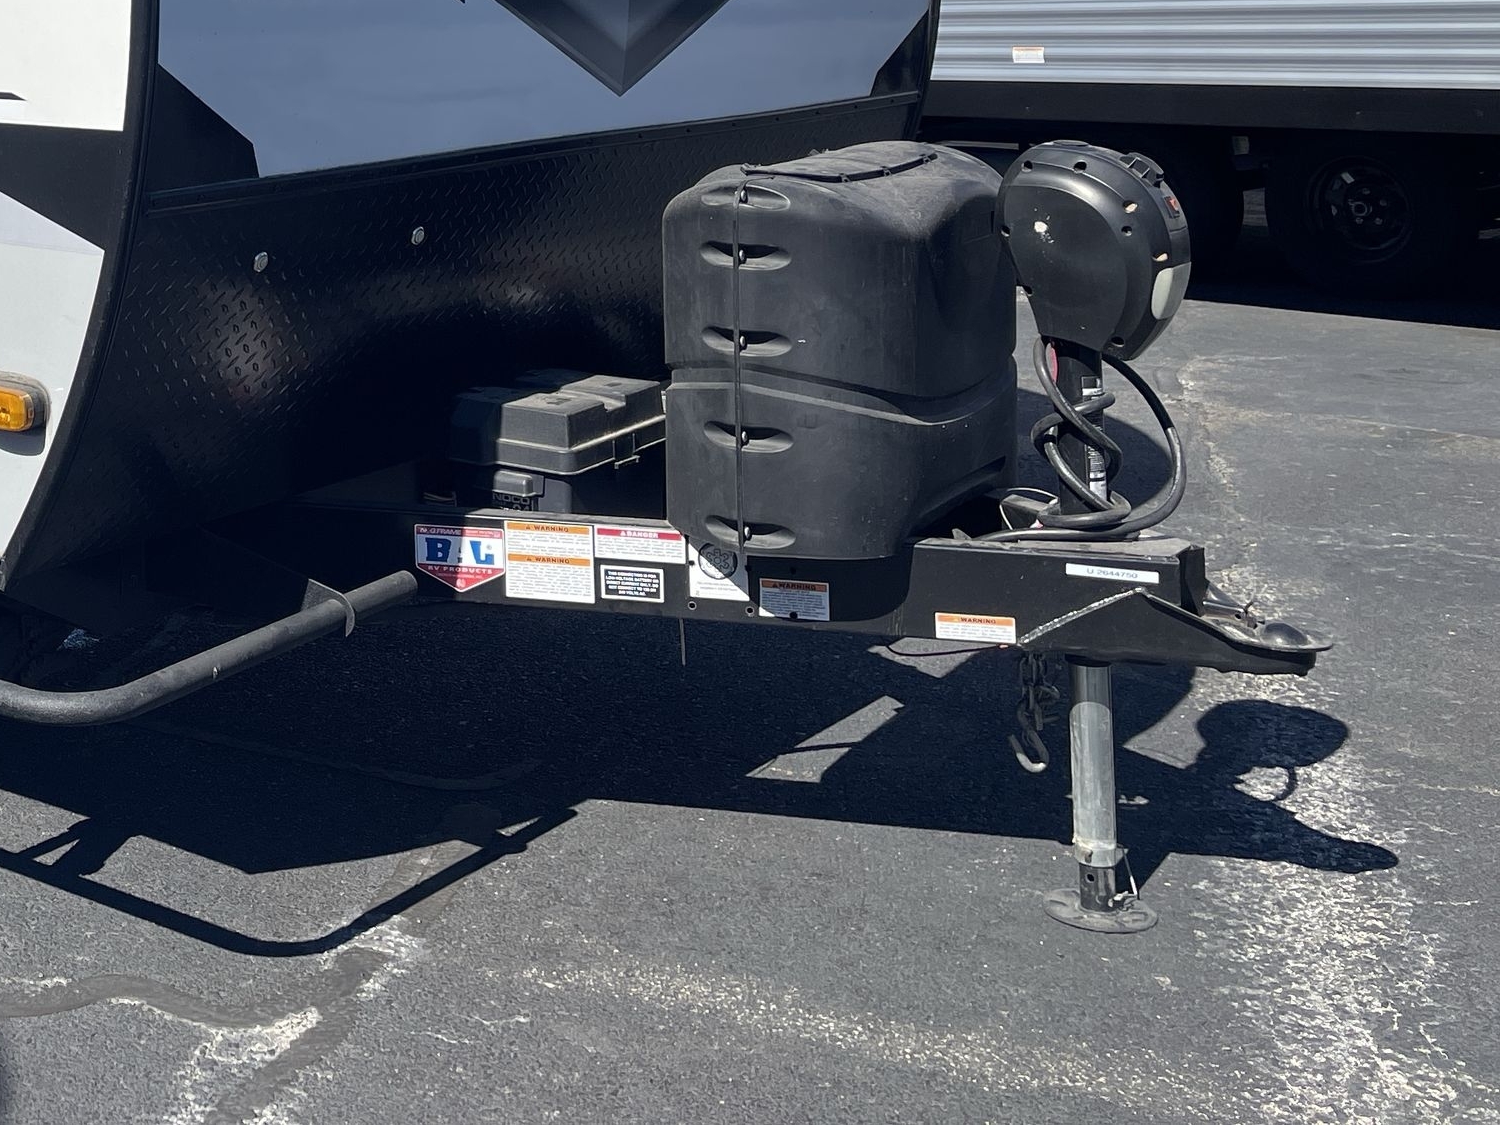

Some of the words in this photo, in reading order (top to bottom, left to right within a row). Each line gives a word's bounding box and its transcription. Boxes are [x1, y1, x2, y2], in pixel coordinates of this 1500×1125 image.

[492, 493, 530, 505] NOCO
[533, 524, 569, 532] WARNING
[626, 530, 659, 539] DANGER
[535, 556, 570, 564] WARNING
[443, 566, 493, 574] PRODUCTS
[779, 581, 816, 590] WARNING
